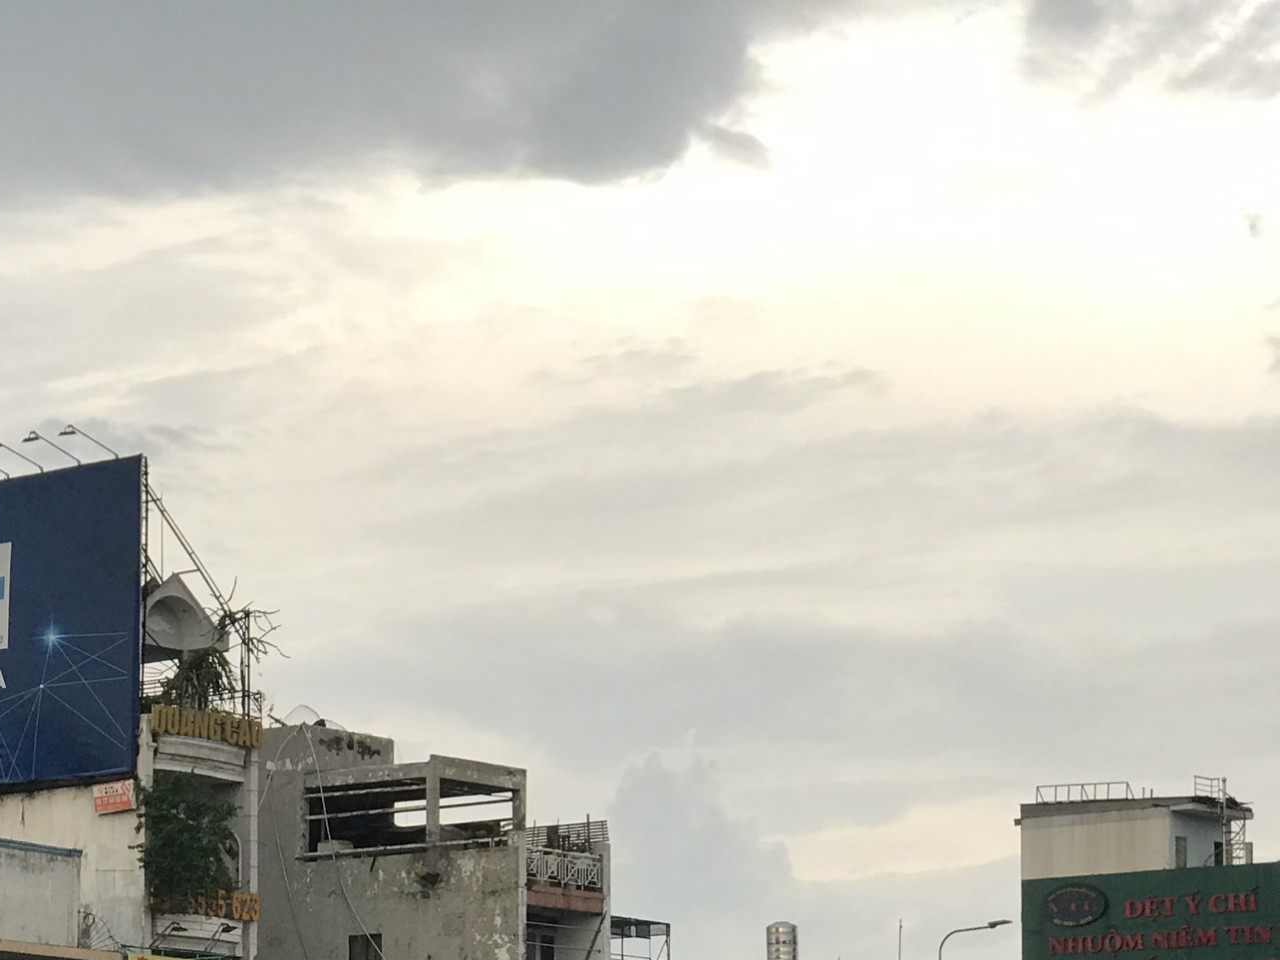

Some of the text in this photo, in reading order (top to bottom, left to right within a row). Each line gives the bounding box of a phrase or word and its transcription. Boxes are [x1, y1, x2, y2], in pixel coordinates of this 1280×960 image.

[232, 889, 261, 921] 623
[1124, 896, 1174, 921] DỆT
[1185, 889, 1202, 914] Ý
[1208, 885, 1260, 913] CHÍ
[1049, 930, 1144, 956] NHUỘM
[1225, 925, 1273, 945] TIN
